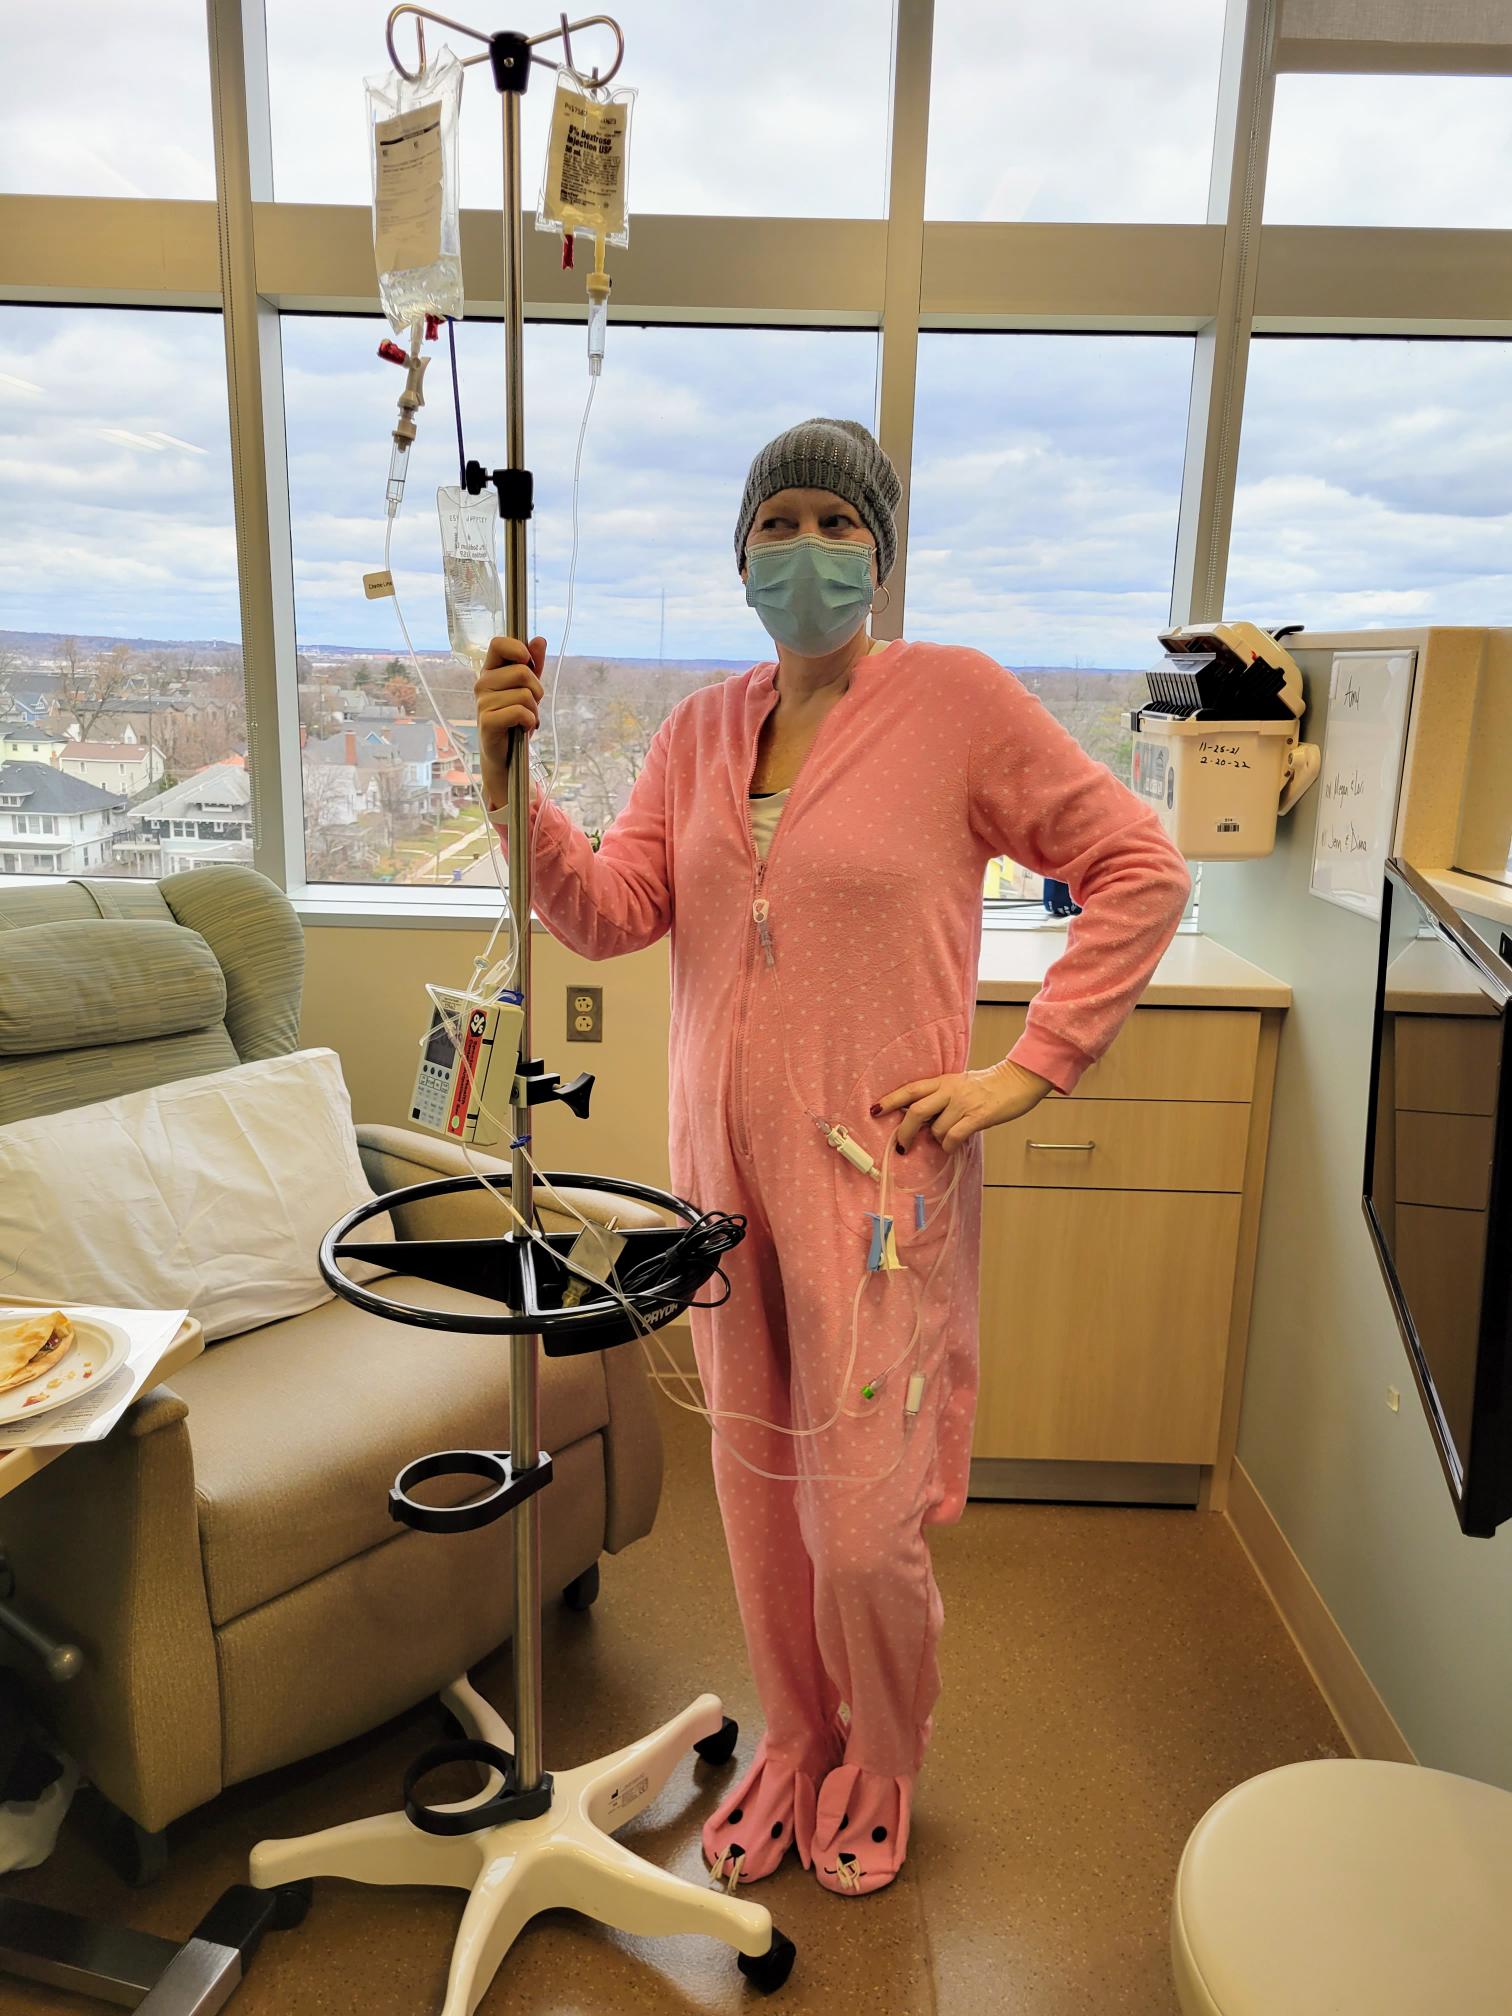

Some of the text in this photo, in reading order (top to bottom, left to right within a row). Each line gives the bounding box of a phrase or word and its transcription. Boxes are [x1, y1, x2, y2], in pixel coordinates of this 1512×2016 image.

[566, 133, 613, 154] Injection USP
[580, 129, 612, 146] Dextrose
[1199, 742, 1240, 755] 11-25-21
[1200, 756, 1251, 769] 2-20-22
